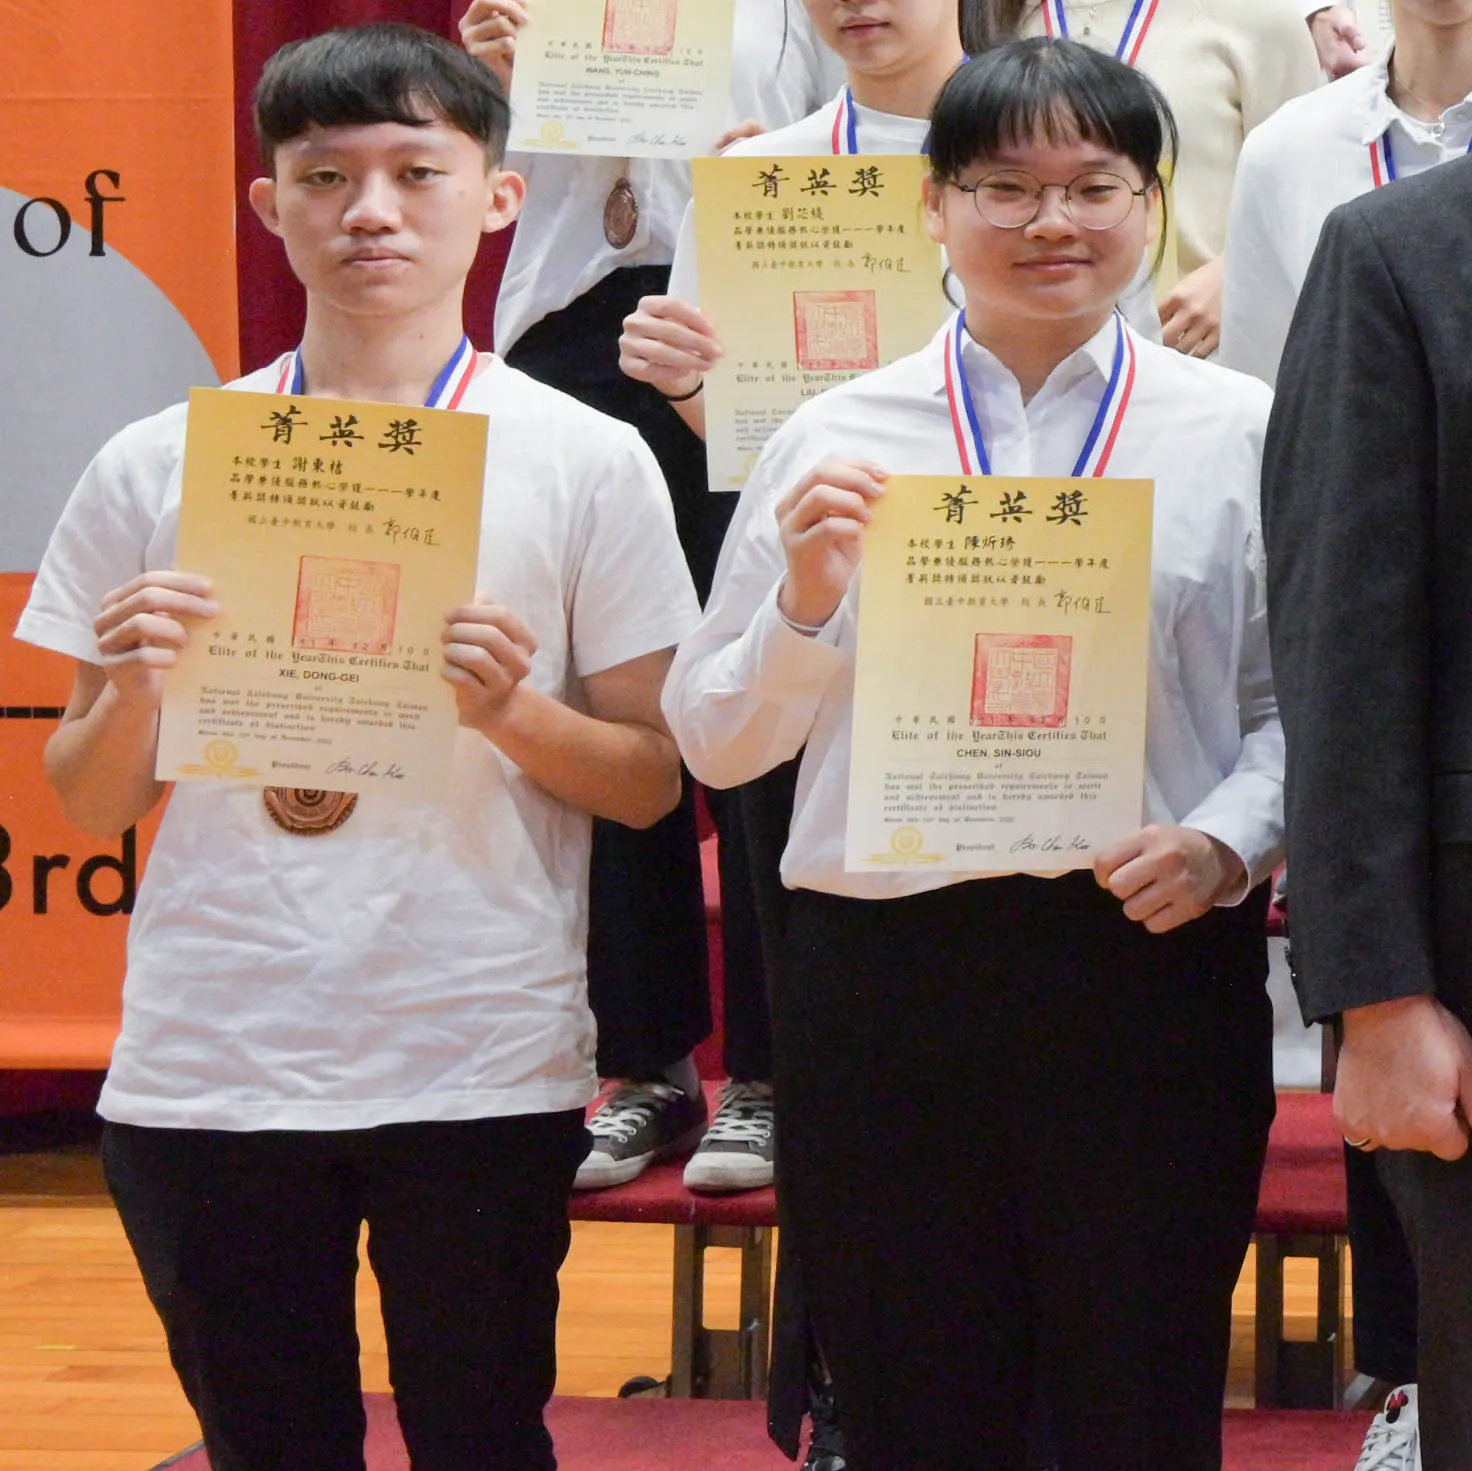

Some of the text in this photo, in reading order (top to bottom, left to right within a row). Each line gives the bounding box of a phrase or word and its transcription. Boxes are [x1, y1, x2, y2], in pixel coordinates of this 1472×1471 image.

[751, 163, 884, 198] 菁英獎
[14, 169, 125, 257] of
[260, 404, 422, 455] 菁英獎
[933, 484, 1088, 525] 菁英獎
[993, 749, 1041, 757] SIN-SIOU
[0, 823, 136, 916] rd
